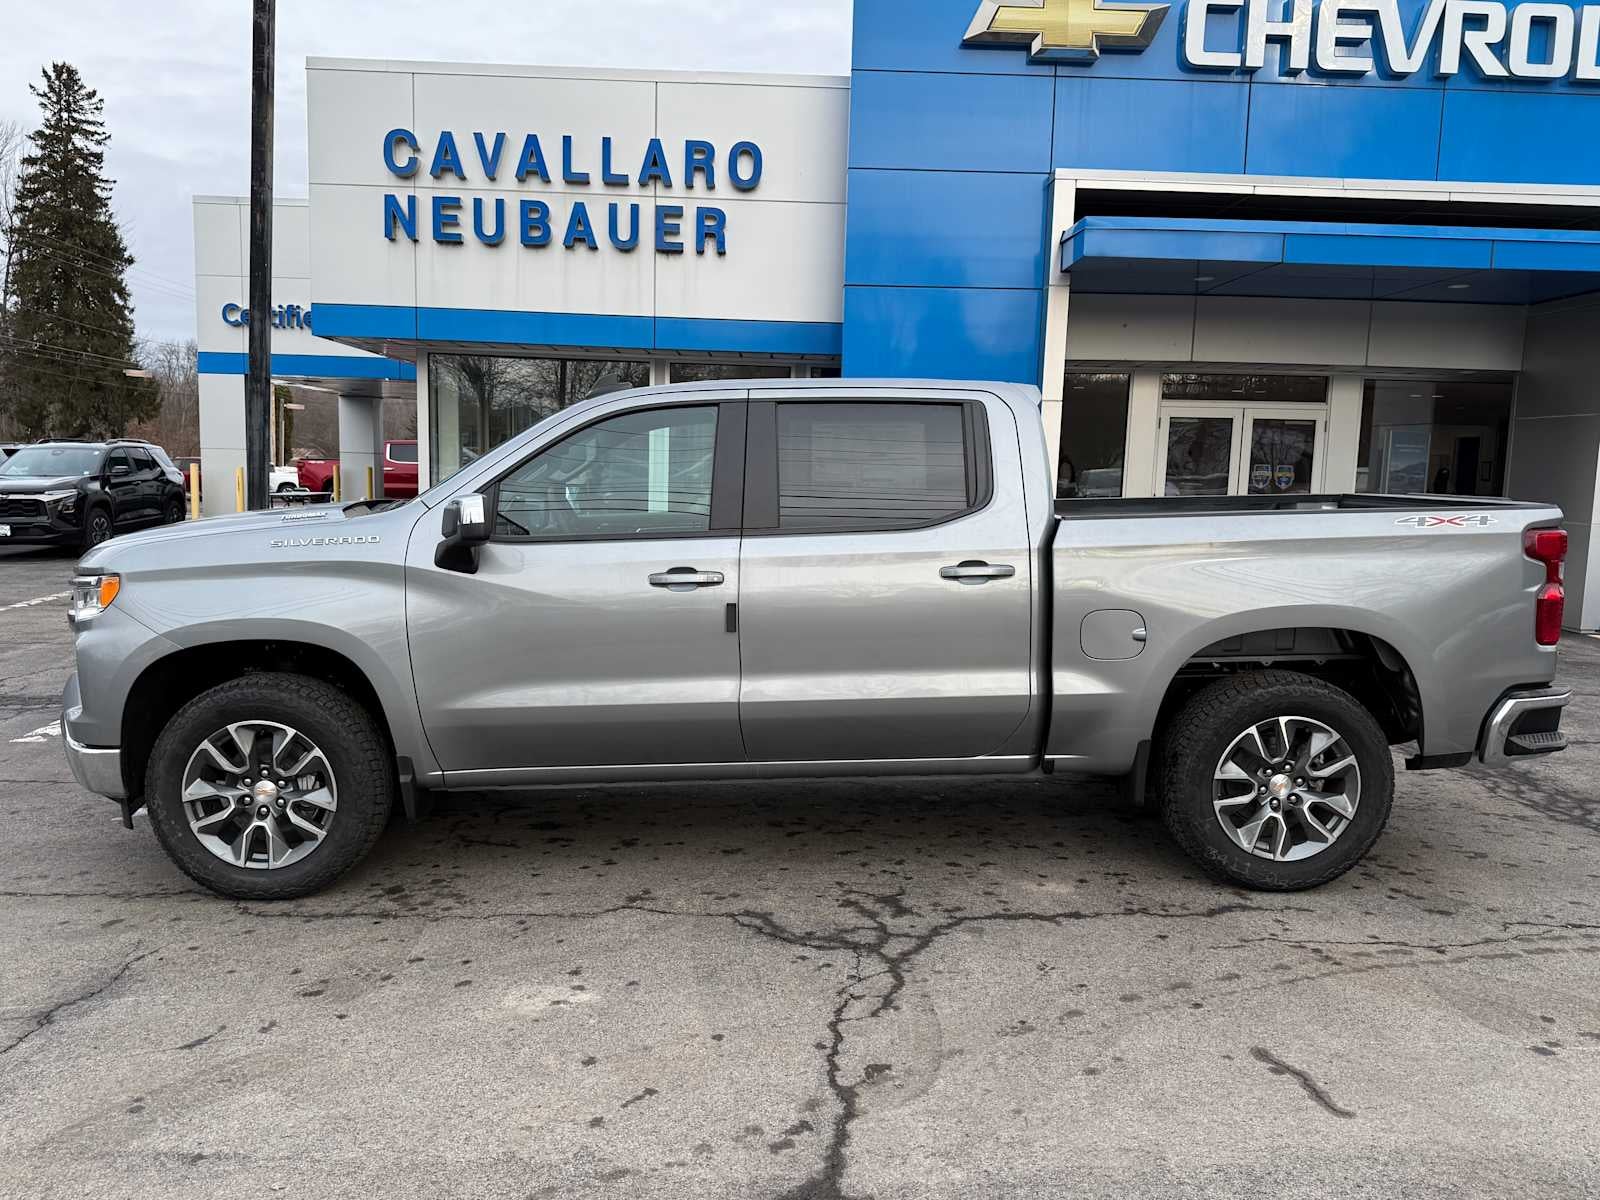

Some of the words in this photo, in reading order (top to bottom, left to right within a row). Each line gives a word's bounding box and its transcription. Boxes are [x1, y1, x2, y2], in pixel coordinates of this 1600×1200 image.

[383, 128, 763, 192] CAVALLARO
[384, 194, 727, 255] NEUBAUER
[270, 535, 381, 548] SILVERADO
